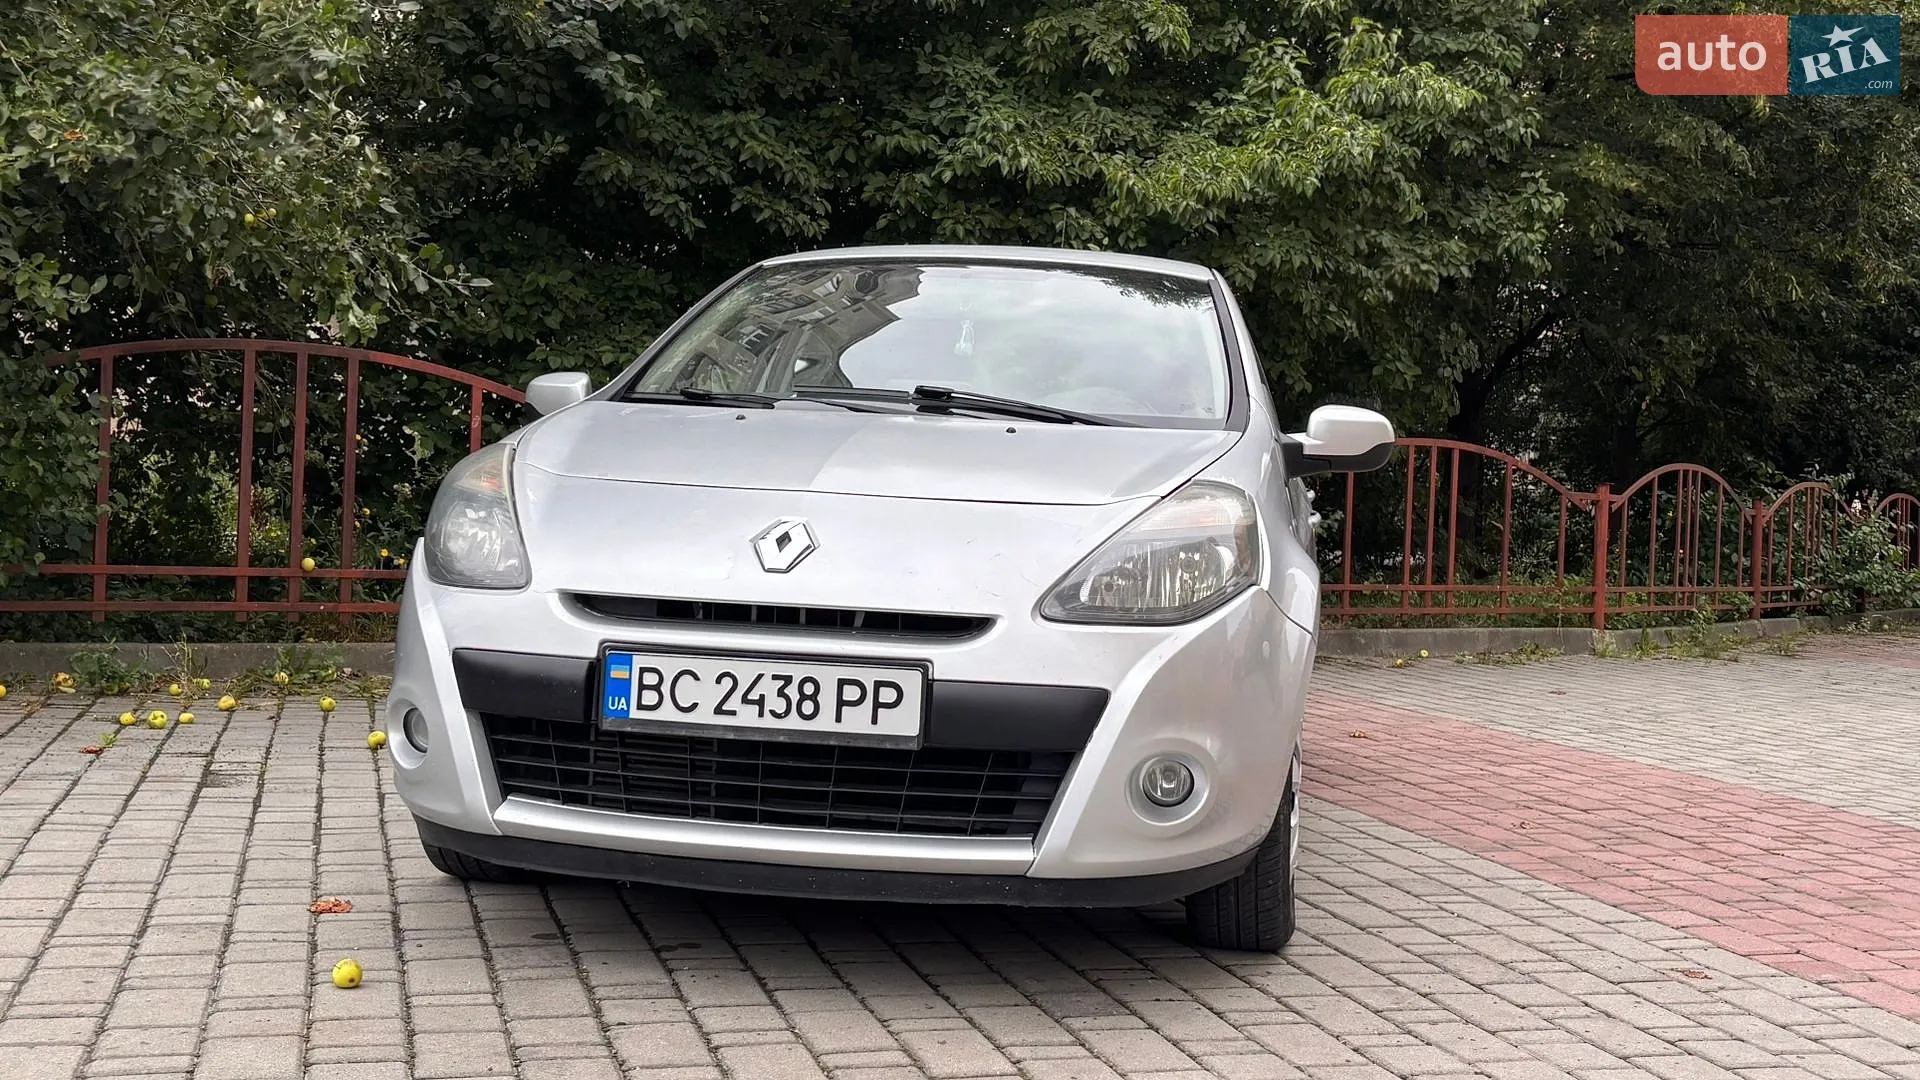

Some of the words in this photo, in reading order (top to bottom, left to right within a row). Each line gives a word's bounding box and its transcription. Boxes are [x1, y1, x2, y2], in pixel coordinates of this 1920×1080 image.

[608, 696, 628, 711] UA
[635, 666, 701, 714] BC
[713, 671, 821, 721] 2438
[835, 678, 904, 726] PP
